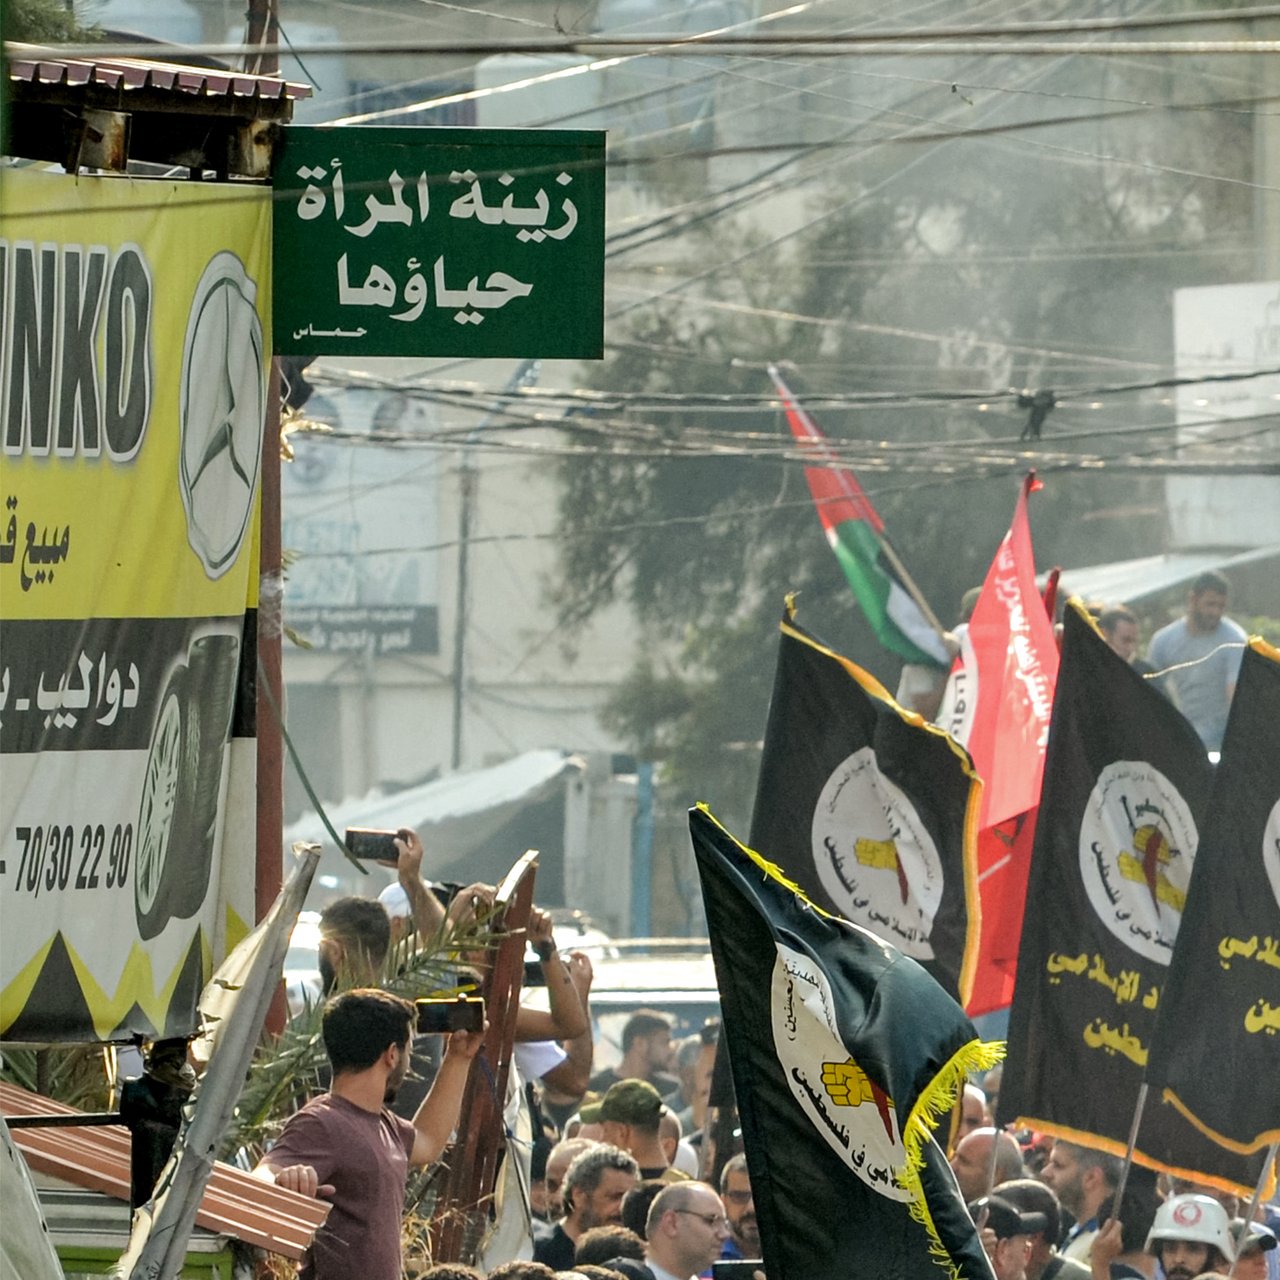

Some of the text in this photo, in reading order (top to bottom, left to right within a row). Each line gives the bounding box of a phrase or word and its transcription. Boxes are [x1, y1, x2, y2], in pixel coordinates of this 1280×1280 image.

[296, 158, 578, 243] زينة المرأة
[337, 252, 534, 325] حياؤها
[0, 241, 152, 462] NKO
[293, 323, 368, 340] حماس
[20, 520, 70, 592] مبيع
[36, 650, 140, 729] دواليب
[15, 822, 133, 899] 70/30 22 90
